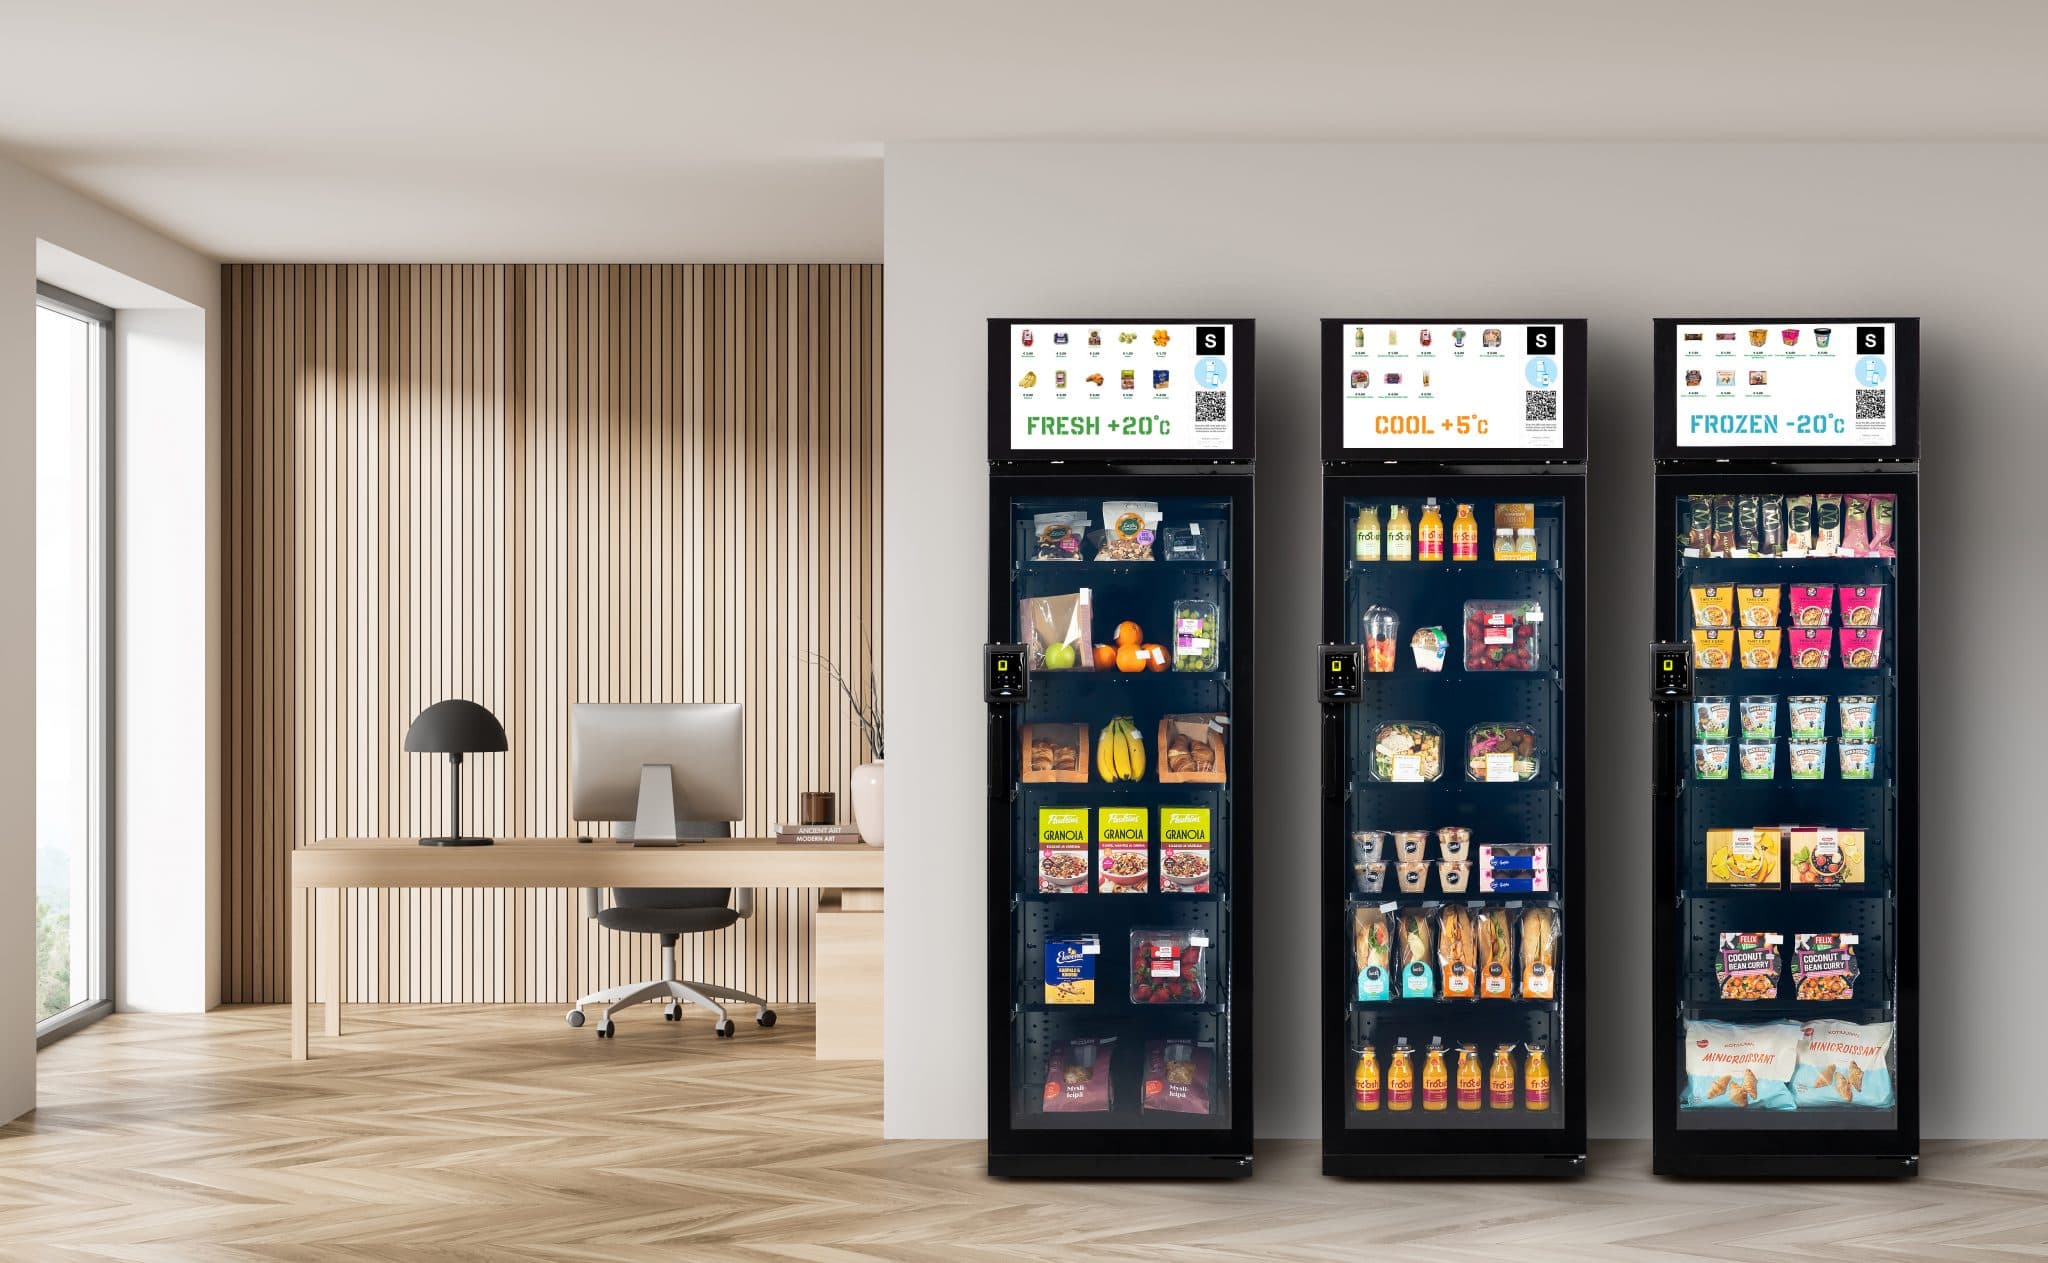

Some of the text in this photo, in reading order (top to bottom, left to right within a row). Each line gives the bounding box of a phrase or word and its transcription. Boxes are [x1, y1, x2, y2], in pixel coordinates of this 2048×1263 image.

[1205, 333, 1217, 348] S
[1536, 333, 1548, 348] S
[1865, 333, 1877, 348] S
[1027, 416, 1100, 435] FRESH
[1375, 415, 1434, 435] COOL
[1691, 415, 1778, 434] FROZEN
[1043, 830, 1083, 840] GRANOLA
[1103, 828, 1143, 839] GRANOLA
[1165, 829, 1205, 840] GRANOLA
[1740, 935, 1758, 944] FELIX
[1815, 936, 1833, 944] FELIX
[1728, 952, 1763, 962] COCONUT
[1803, 953, 1838, 963] COCONUT
[1729, 961, 1769, 970] BEAN CURRY
[1804, 961, 1844, 972] BEAN CURRY
[1809, 1041, 1882, 1057] MINICROISSANT
[1701, 1052, 1776, 1065] MINICROISSANT
